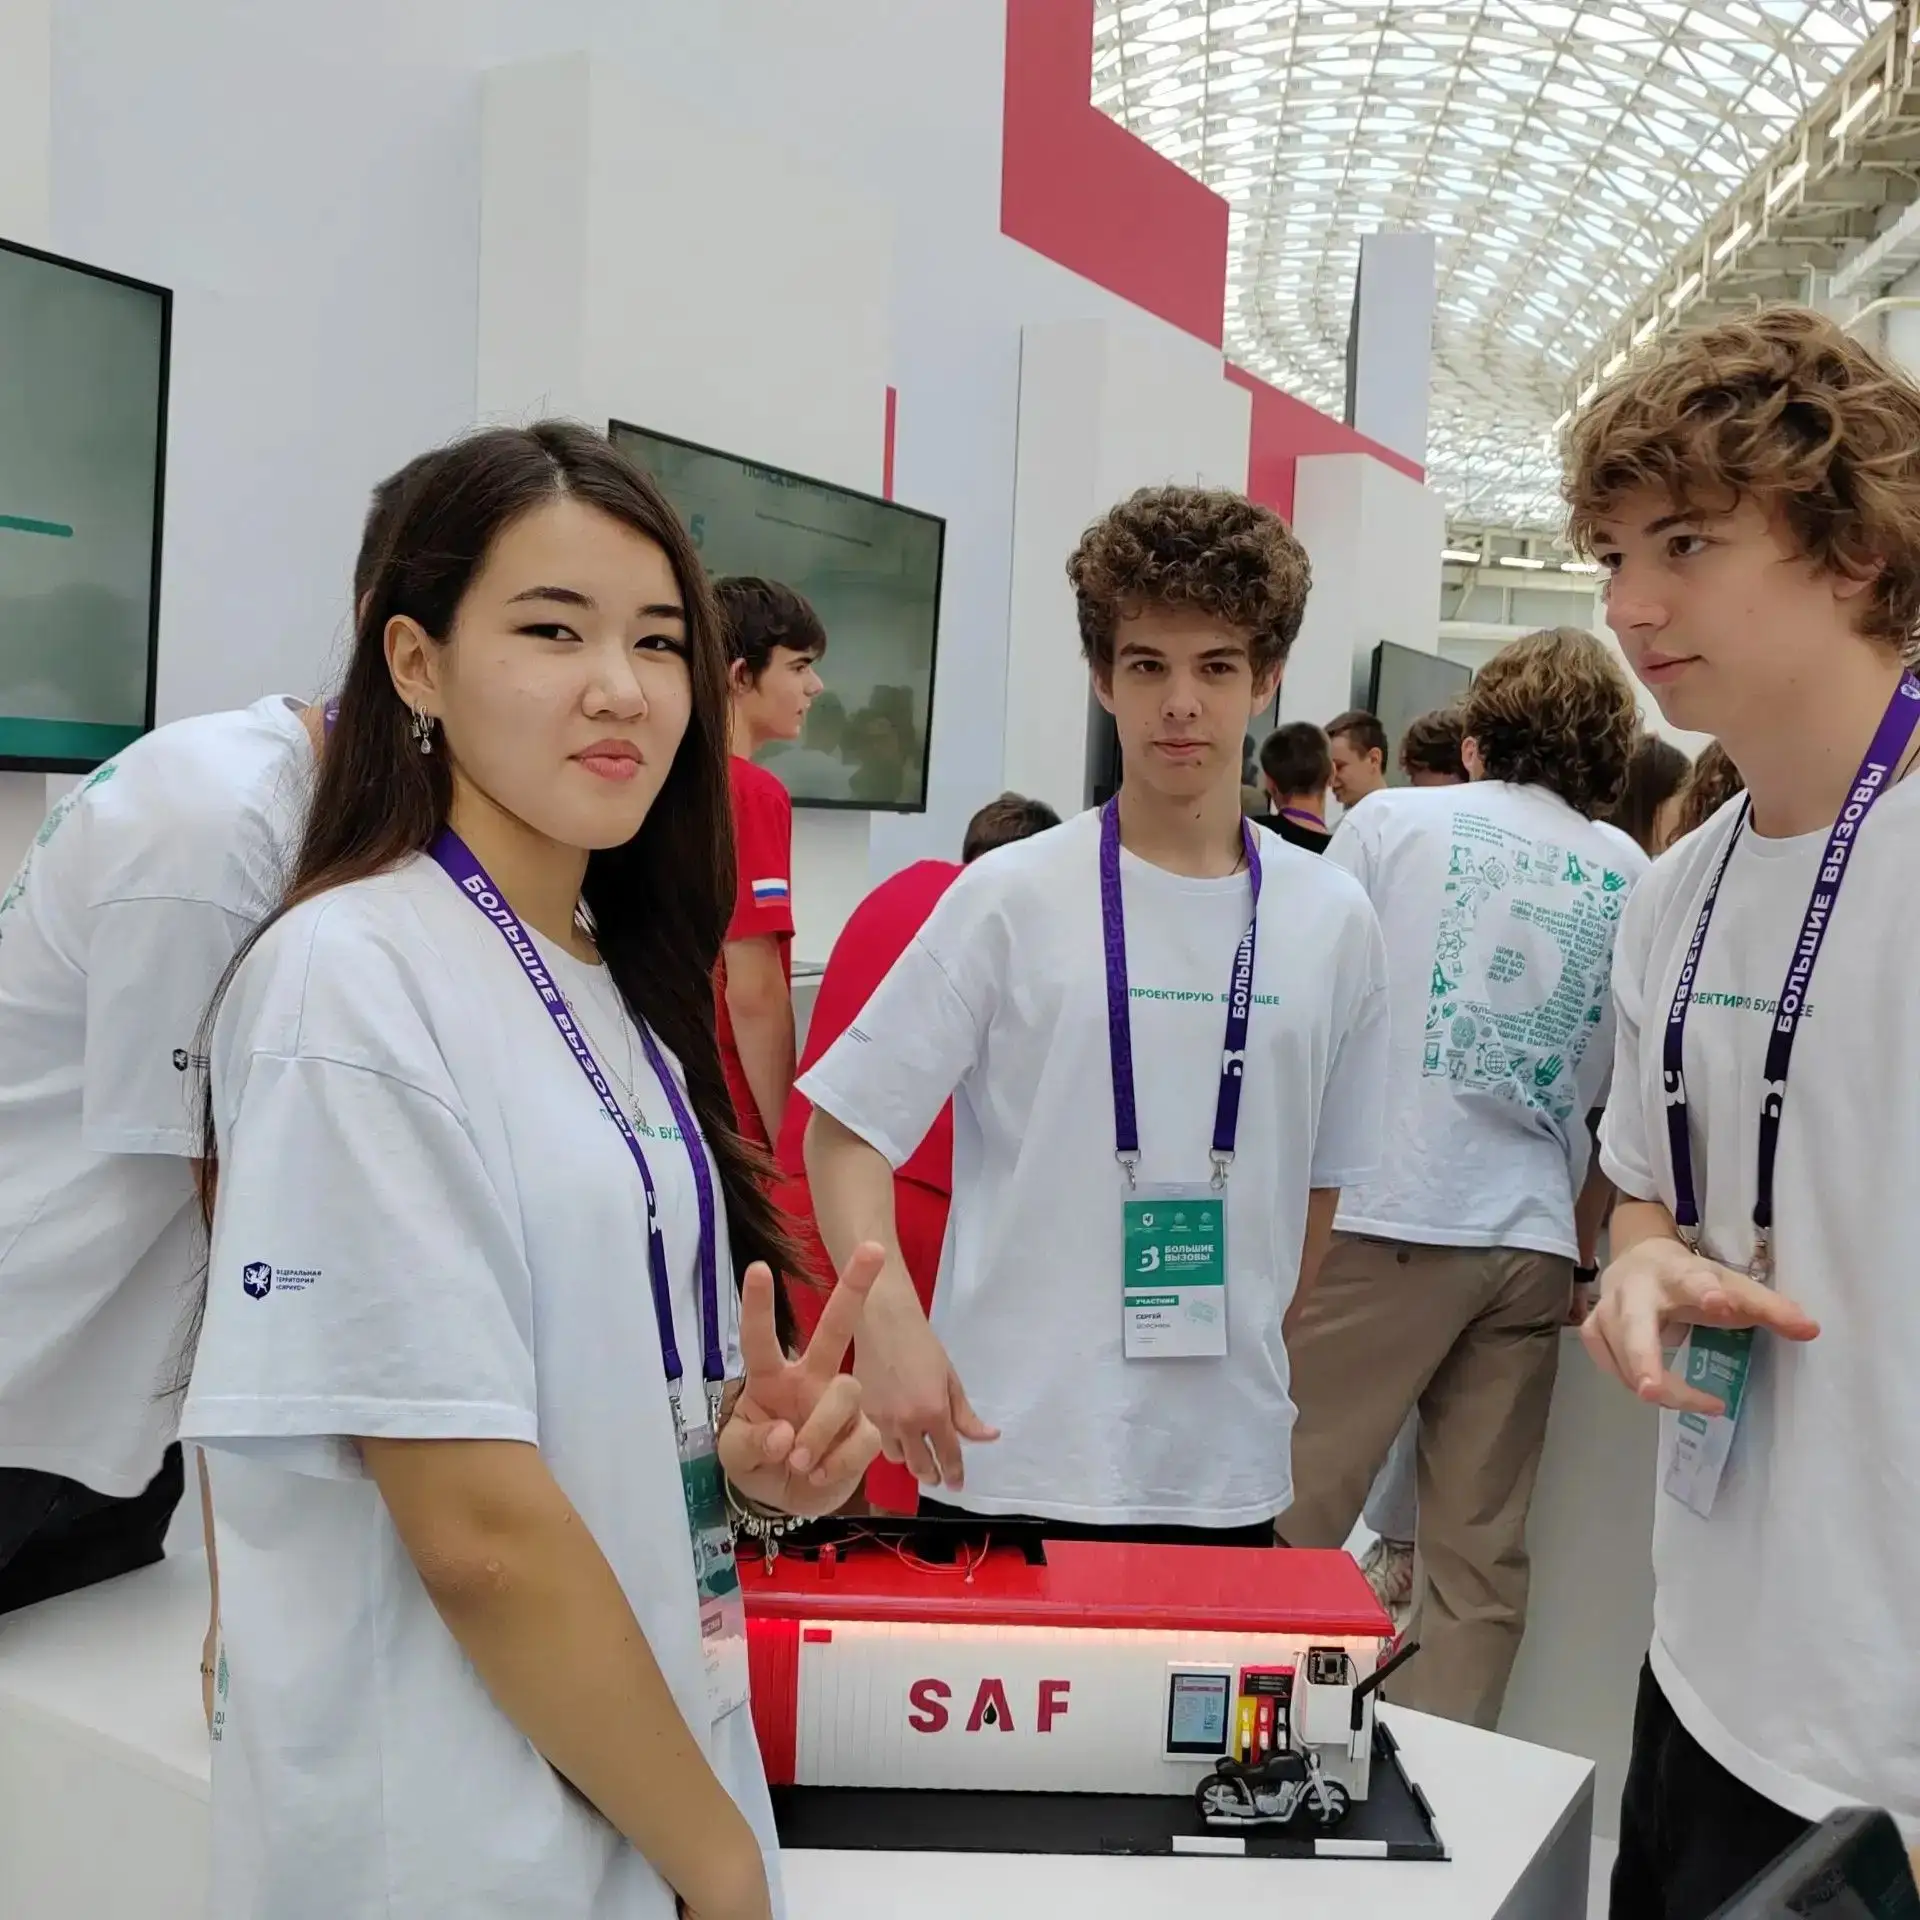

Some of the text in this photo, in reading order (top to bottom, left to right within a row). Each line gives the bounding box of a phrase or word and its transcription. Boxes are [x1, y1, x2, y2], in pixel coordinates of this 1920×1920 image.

[1776, 762, 1888, 1033] БОЛЬШИЕ ВЫЗОВЫ
[1669, 910, 1710, 1024] ВЫЗОВЫ
[460, 874, 633, 1138] БОЛЬШИЕ ВЫЗОВЫ
[1129, 987, 1280, 1005] ПРОЕКТИРУЮ БУЩЕЕ
[1753, 998, 1814, 1018] БУДЕЕ
[1164, 1244, 1215, 1254] БОЛЬШИЕ
[1164, 1253, 1210, 1262] ВЫЗОВЫ
[908, 1678, 1071, 1733] SAF
